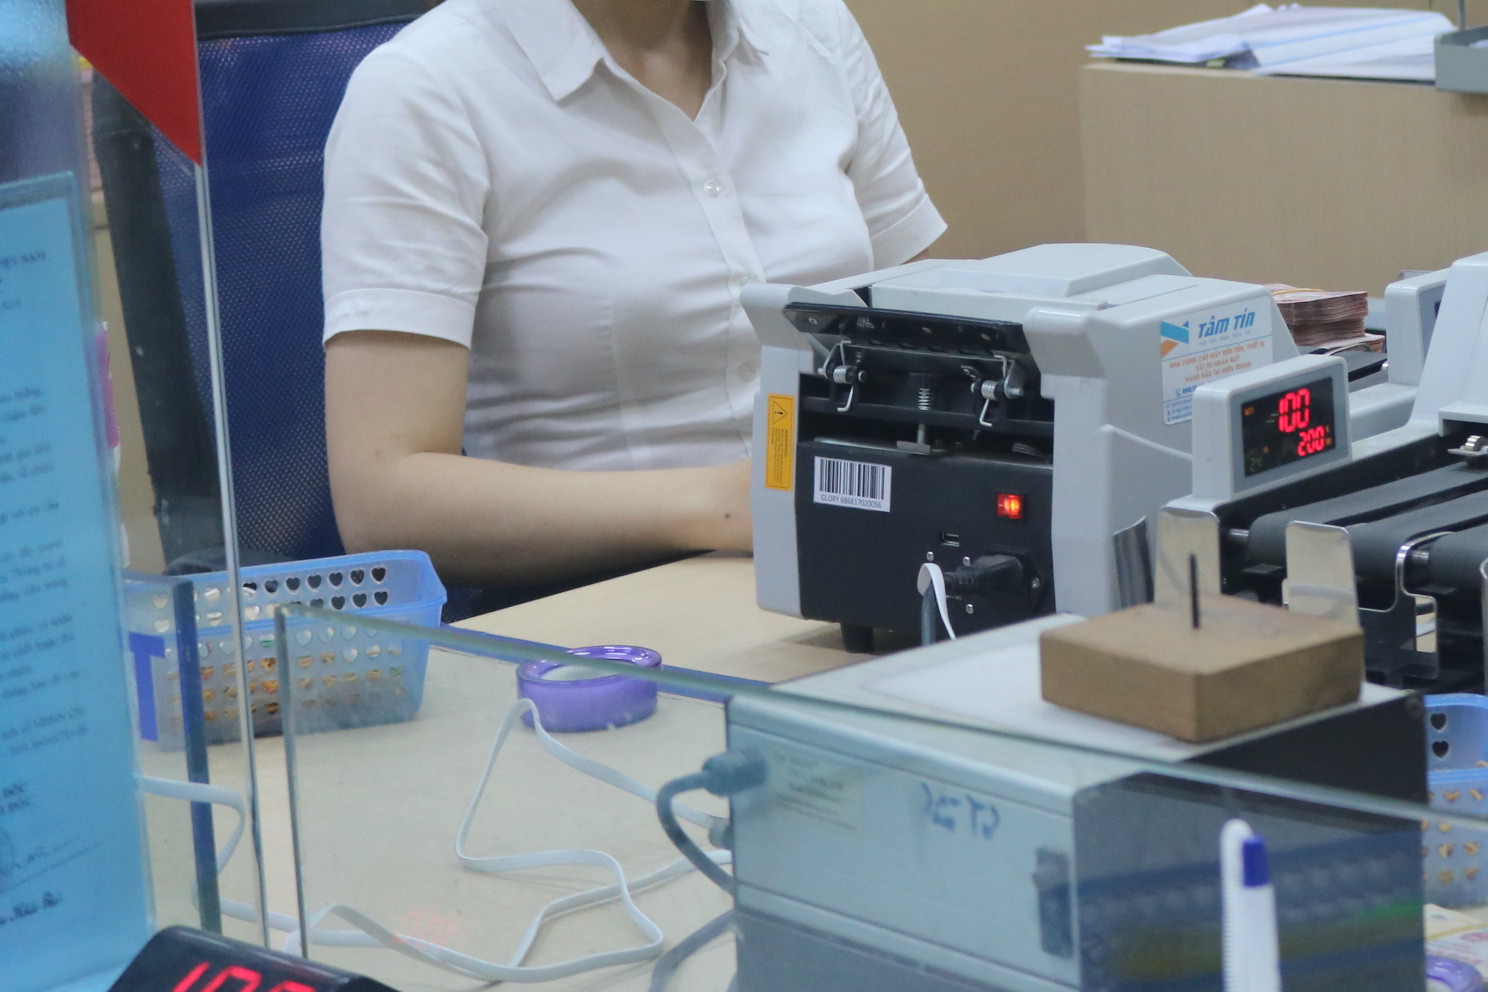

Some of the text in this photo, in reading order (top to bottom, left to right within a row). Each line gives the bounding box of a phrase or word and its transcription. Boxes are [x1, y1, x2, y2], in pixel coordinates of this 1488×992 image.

[1278, 388, 1311, 433] 100
[1297, 425, 1325, 457] 200
[820, 493, 840, 503] GLORY
